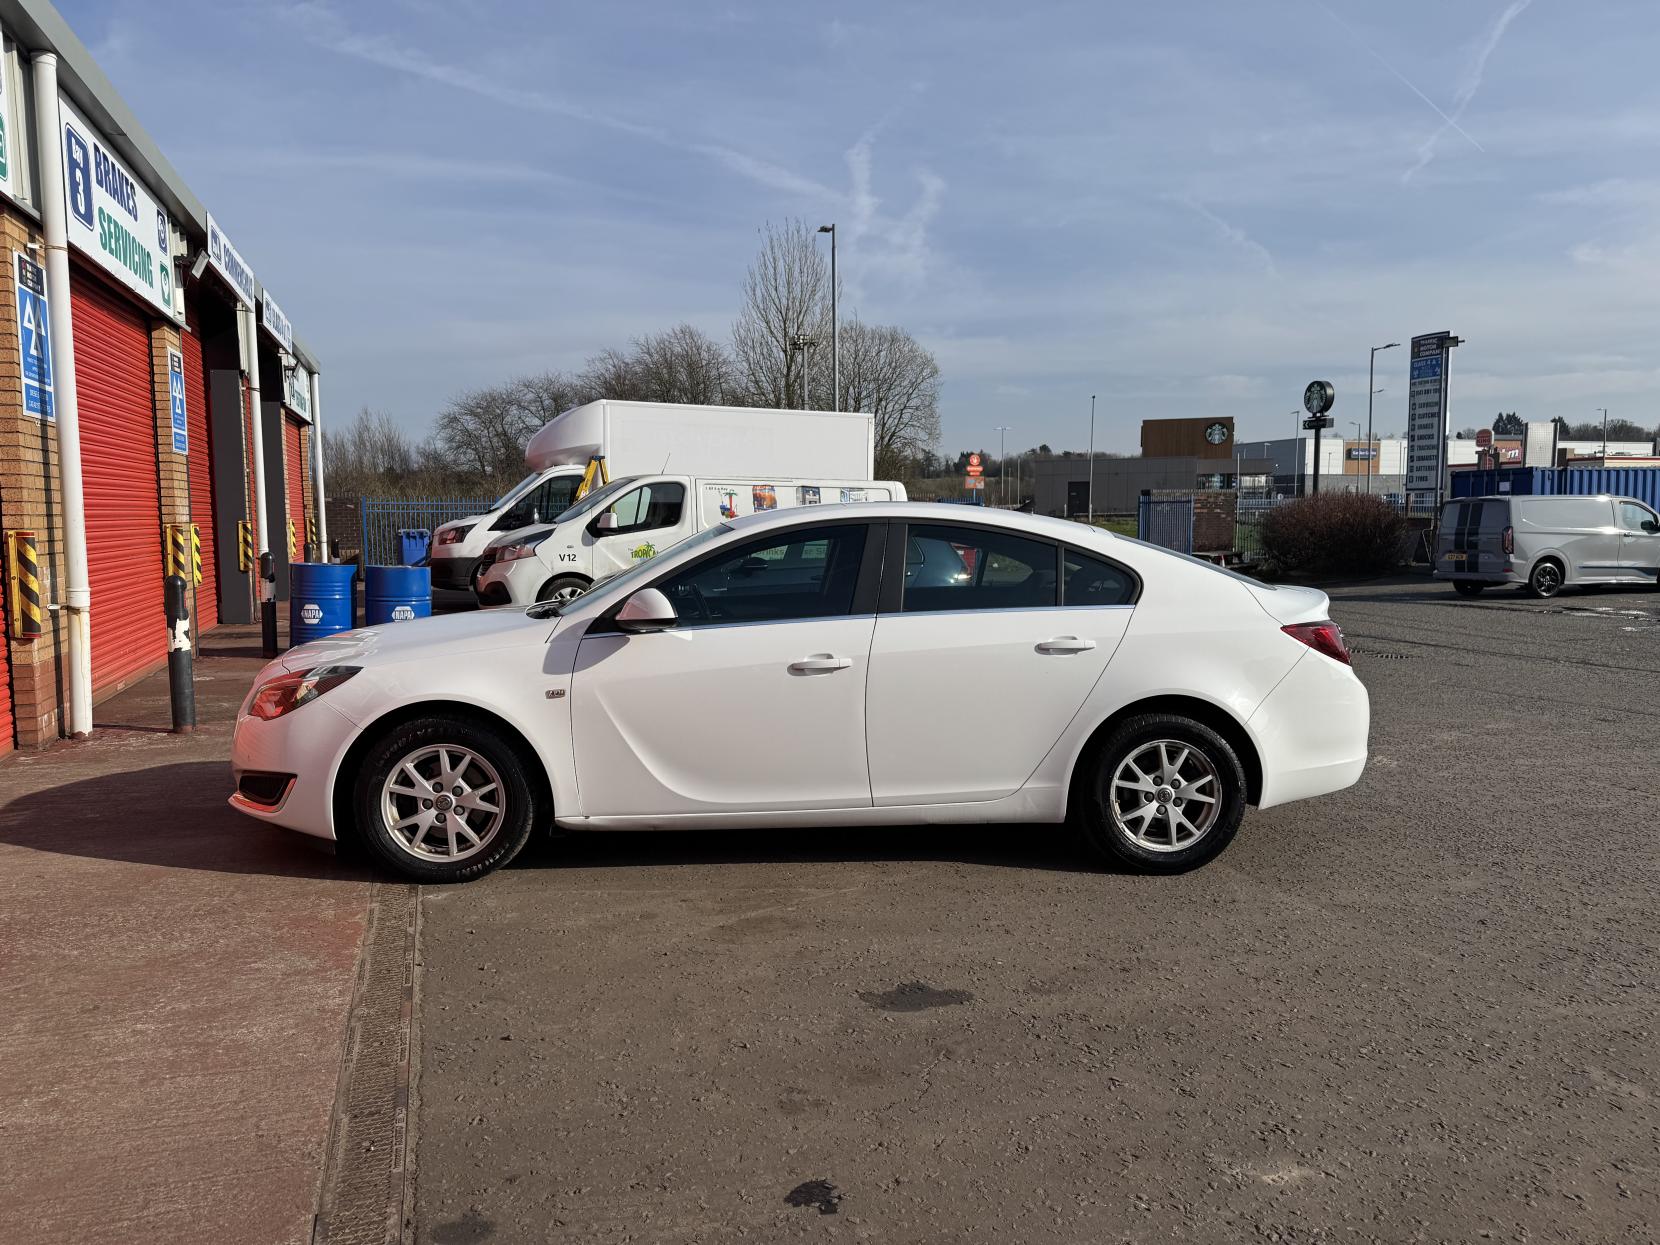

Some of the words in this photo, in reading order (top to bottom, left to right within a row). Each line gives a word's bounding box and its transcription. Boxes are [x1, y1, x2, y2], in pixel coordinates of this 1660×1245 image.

[71, 136, 84, 168] Bay
[75, 170, 86, 215] 3
[93, 142, 138, 223] BRAKES
[98, 206, 154, 289] SERVICING
[558, 553, 577, 562] V12
[631, 548, 659, 559] TROPICA
[304, 609, 320, 618] NAPA
[395, 611, 411, 620] NAPA
